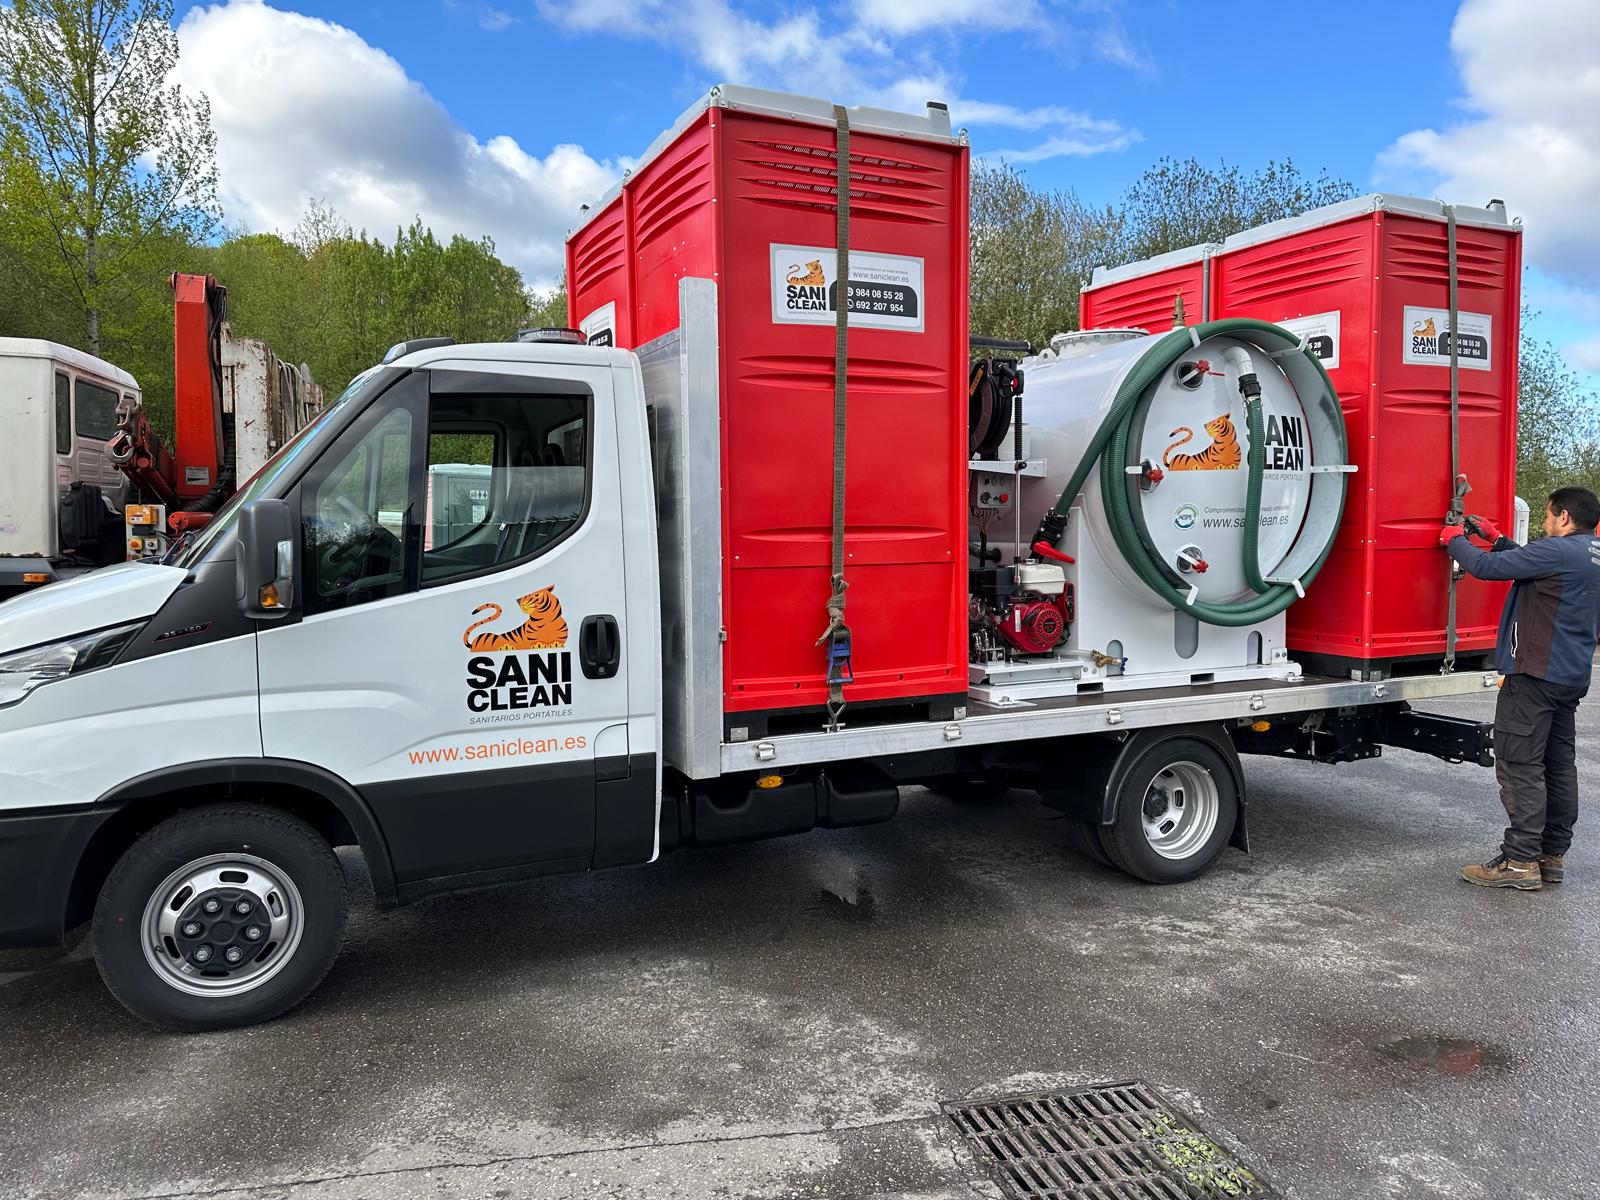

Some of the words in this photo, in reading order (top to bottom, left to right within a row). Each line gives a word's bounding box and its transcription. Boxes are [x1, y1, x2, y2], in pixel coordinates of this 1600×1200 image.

[853, 271, 909, 283] www.saniclean.es
[786, 285, 826, 300] SANI
[855, 288, 870, 297] 984
[871, 289, 882, 298] 08
[883, 291, 893, 299] 55
[894, 291, 904, 301] 28
[787, 299, 827, 311] CLEAN
[855, 300, 871, 310] 692
[873, 302, 887, 311] 207
[890, 303, 904, 312] 954
[1412, 336, 1436, 347] SANI
[1412, 347, 1437, 355] CLEAN
[1248, 415, 1303, 448] ANI
[1249, 447, 1304, 472] LEAN
[1203, 514, 1289, 528] www.salean.es
[466, 651, 572, 689] SANI
[466, 683, 572, 713] CLEAN
[469, 713, 521, 725] SANITARIOS
[523, 709, 573, 719] PORTÁTILES
[408, 735, 587, 765] www.saniclean.es
